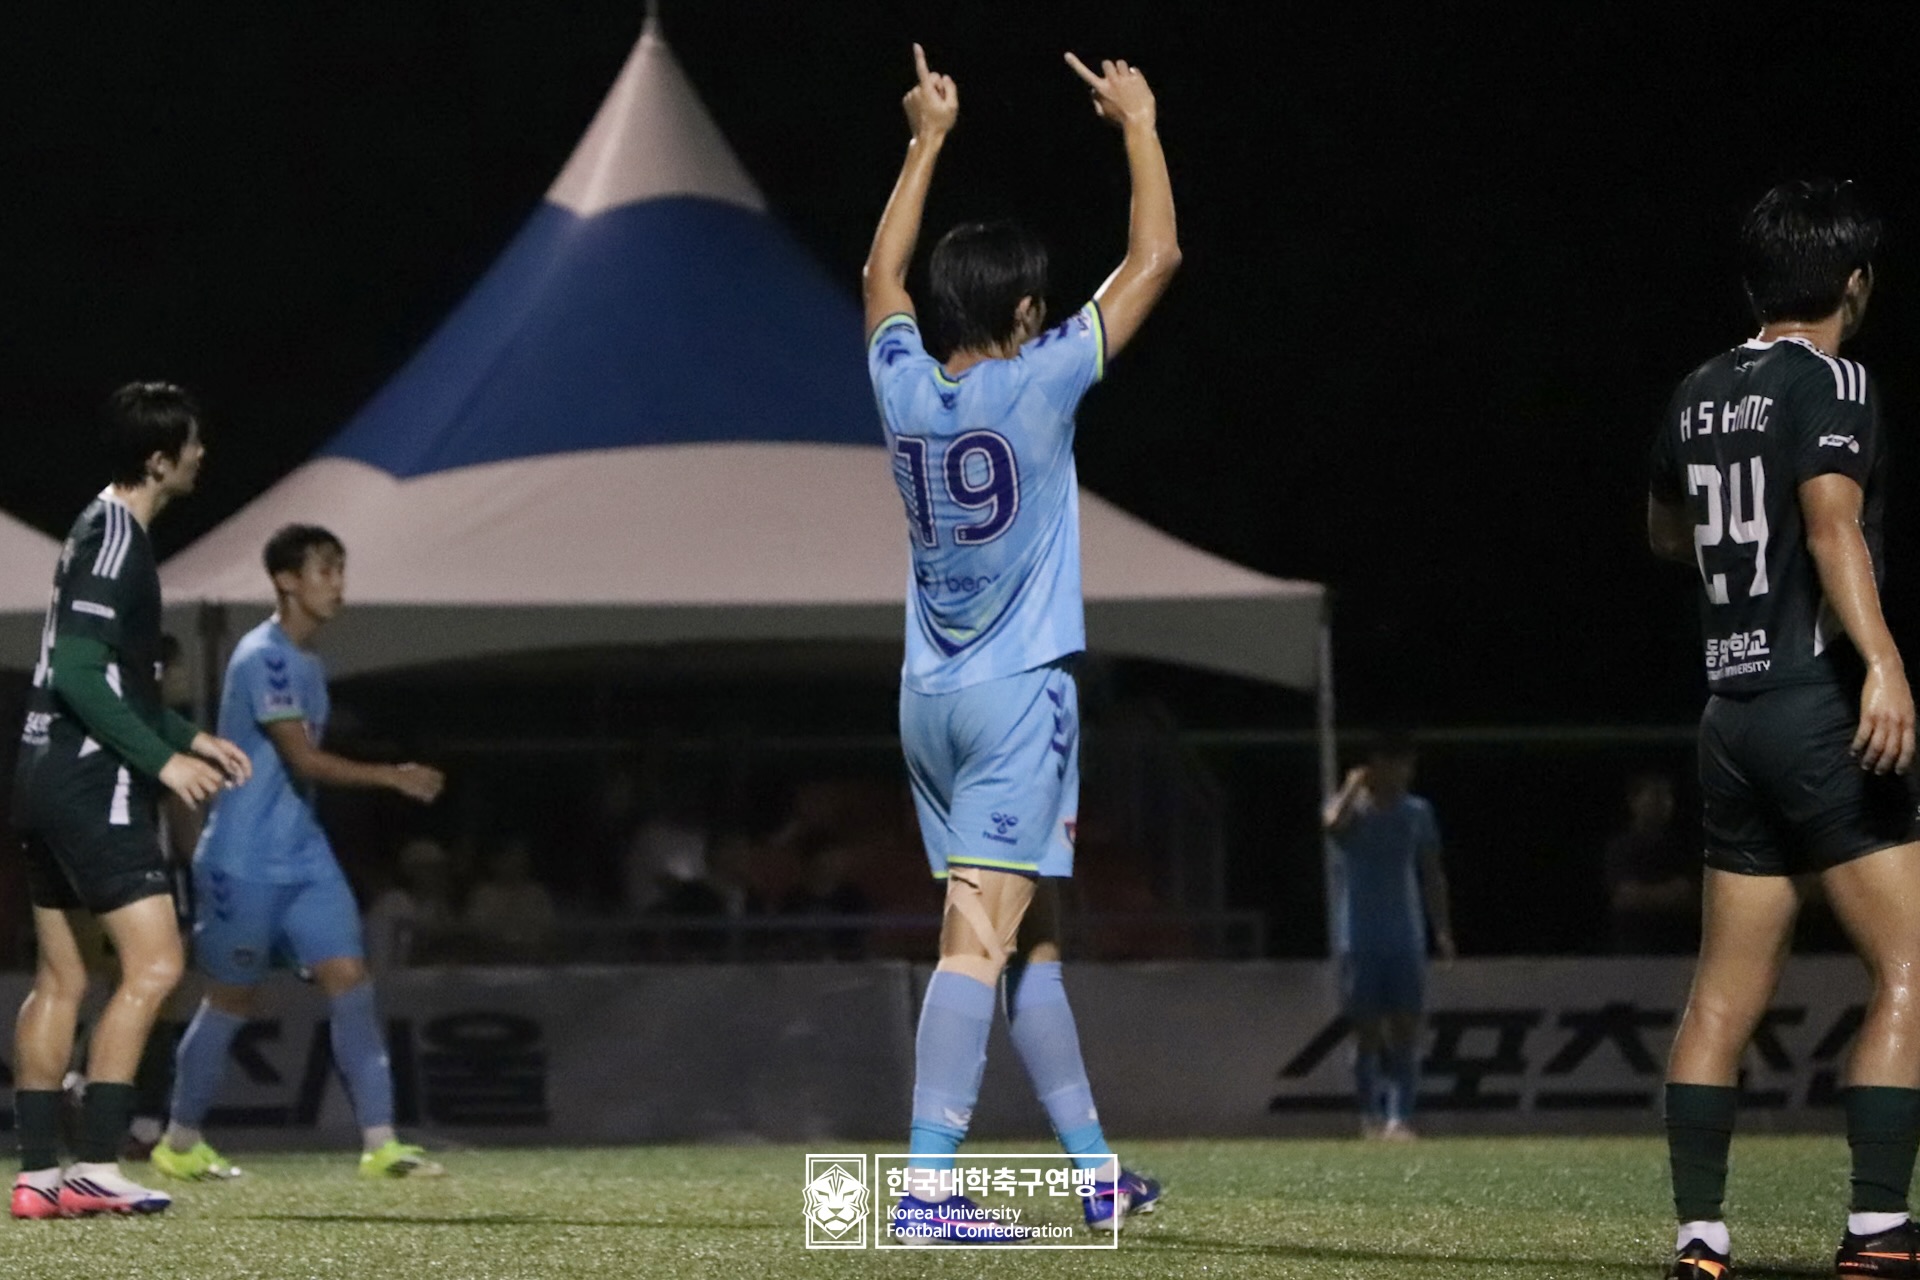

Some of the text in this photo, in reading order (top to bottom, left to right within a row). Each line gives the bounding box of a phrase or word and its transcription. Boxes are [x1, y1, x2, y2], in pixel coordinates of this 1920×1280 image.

[1680, 406, 1692, 443] H
[1698, 401, 1714, 435] S
[895, 428, 1019, 548] 19
[1687, 456, 1770, 605] 24
